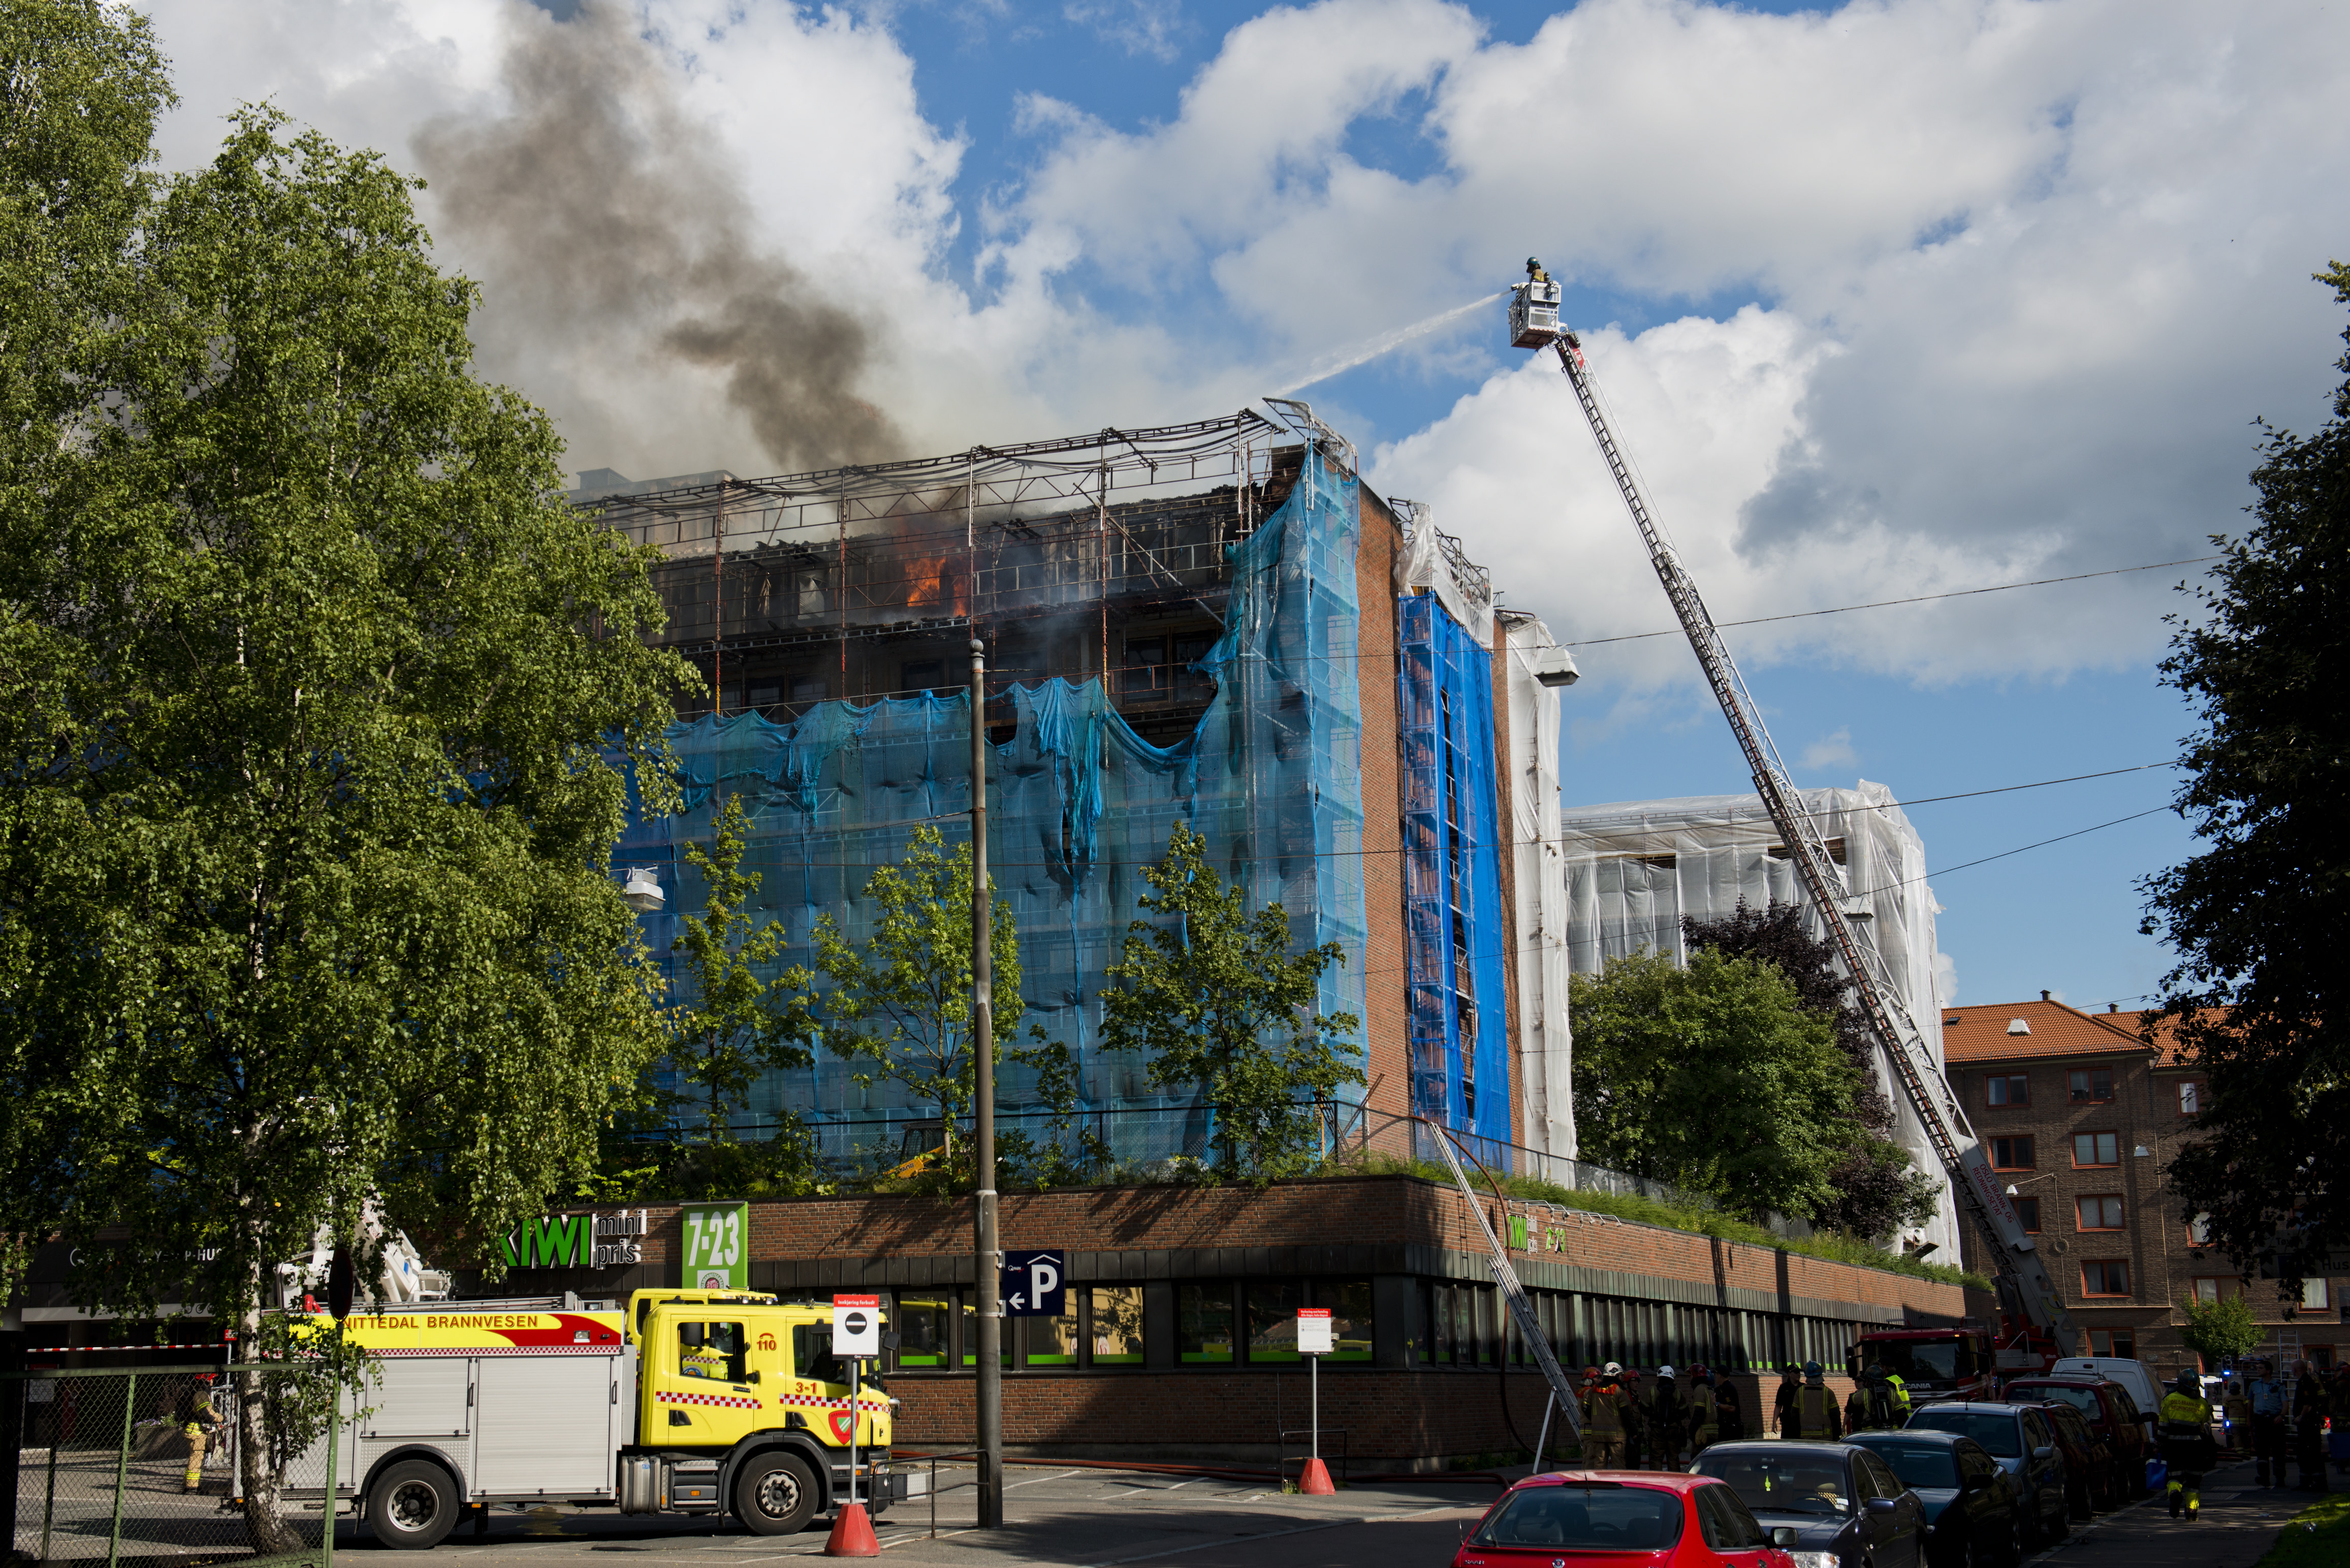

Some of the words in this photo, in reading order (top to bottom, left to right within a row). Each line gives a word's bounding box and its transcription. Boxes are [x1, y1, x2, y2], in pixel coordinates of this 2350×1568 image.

[898, 1162, 915, 1172] TANG
[1972, 1167, 2003, 1217] REDNINGSETAT
[1980, 1164, 1993, 1183] OSLO
[1990, 1184, 2007, 1210] BRANN-
[2005, 1211, 2015, 1223] OG
[597, 1210, 644, 1236] mini
[1504, 1214, 1528, 1251] KIWI
[688, 1211, 739, 1266] 7-23
[2276, 1237, 2303, 1246] Tøyn
[596, 1238, 639, 1270] pris
[1031, 1264, 1058, 1309] P
[343, 1317, 420, 1329] NITTEDAL
[427, 1316, 538, 1329] BRANNVESEN
[756, 1340, 777, 1351] 110
[796, 1382, 817, 1395] 3-1
